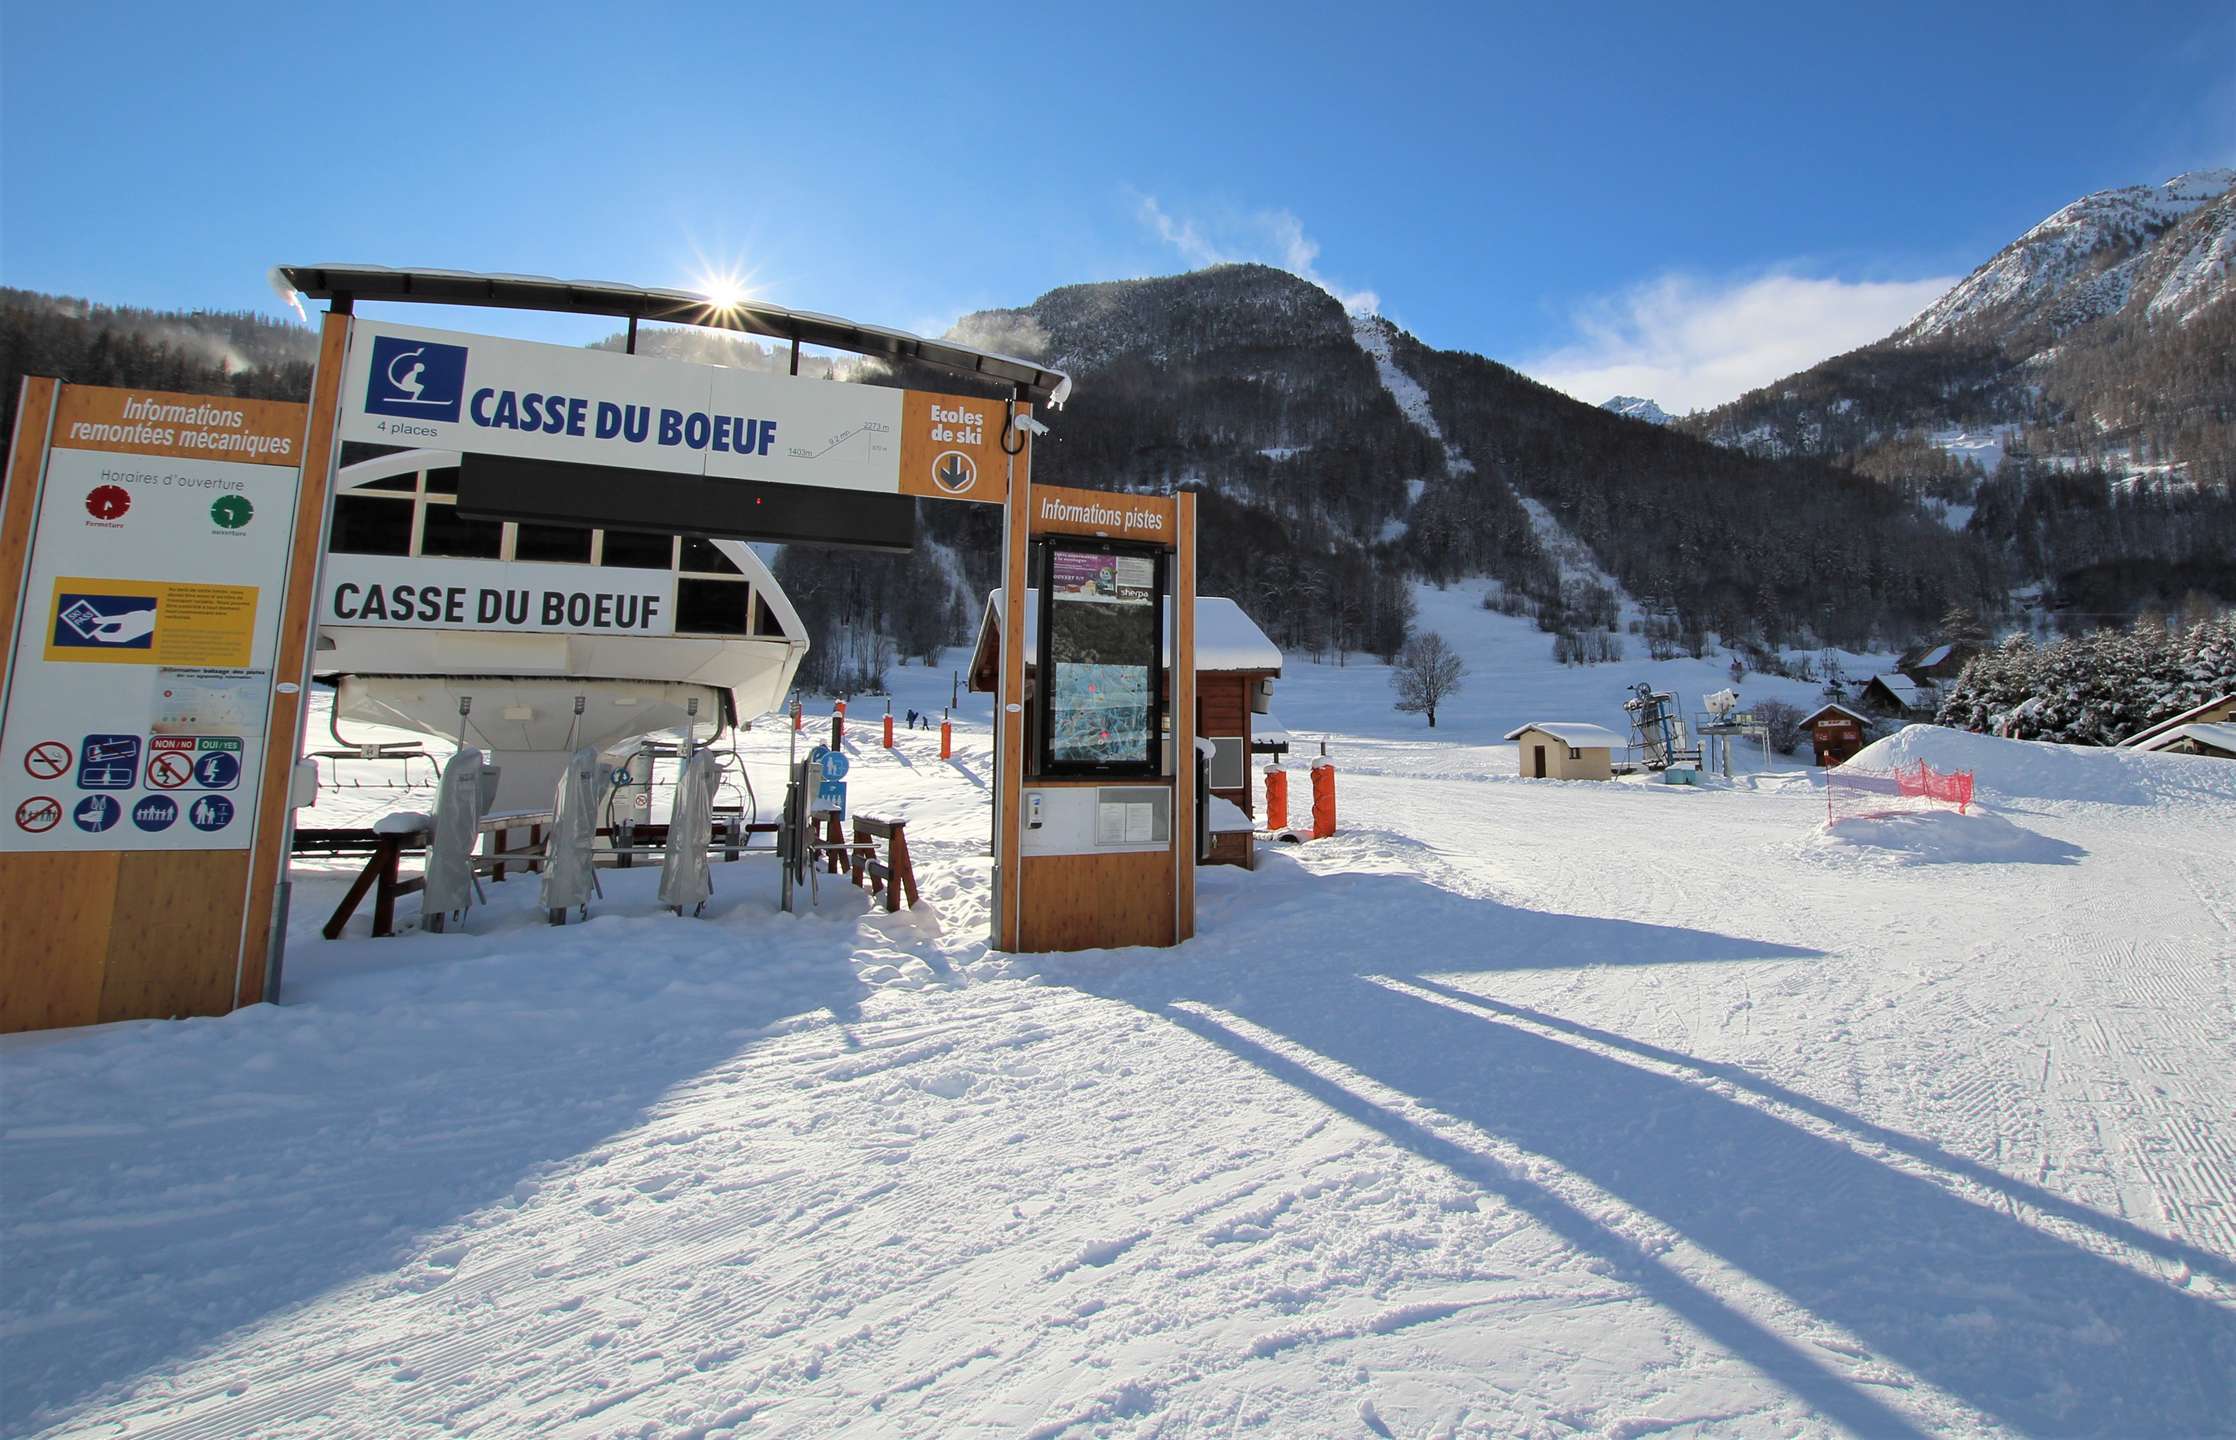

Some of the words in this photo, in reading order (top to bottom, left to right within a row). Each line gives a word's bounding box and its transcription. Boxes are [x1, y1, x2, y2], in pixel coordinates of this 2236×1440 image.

[122, 396, 244, 428] Informations
[470, 388, 588, 436] CASSE
[595, 401, 650, 443] DU
[658, 409, 777, 456] BOEUF
[931, 405, 983, 426] Ecoles
[69, 420, 175, 447] remontées
[179, 426, 292, 457] mécaniques
[377, 421, 386, 431] 4
[391, 423, 438, 437] places
[931, 423, 953, 442] de
[956, 426, 982, 444] ski
[101, 469, 158, 485] Horaires
[163, 474, 244, 491] d'ouverture
[1041, 497, 1121, 526] Informations
[1124, 507, 1163, 532] pistes
[1121, 588, 1149, 598] sherpa
[333, 583, 467, 623] CASSE
[477, 588, 530, 624] DU
[541, 591, 660, 629] BOEUF
[155, 740, 176, 748] NON
[181, 741, 193, 749] NO
[202, 741, 218, 749] OUI
[224, 742, 238, 750] YES
